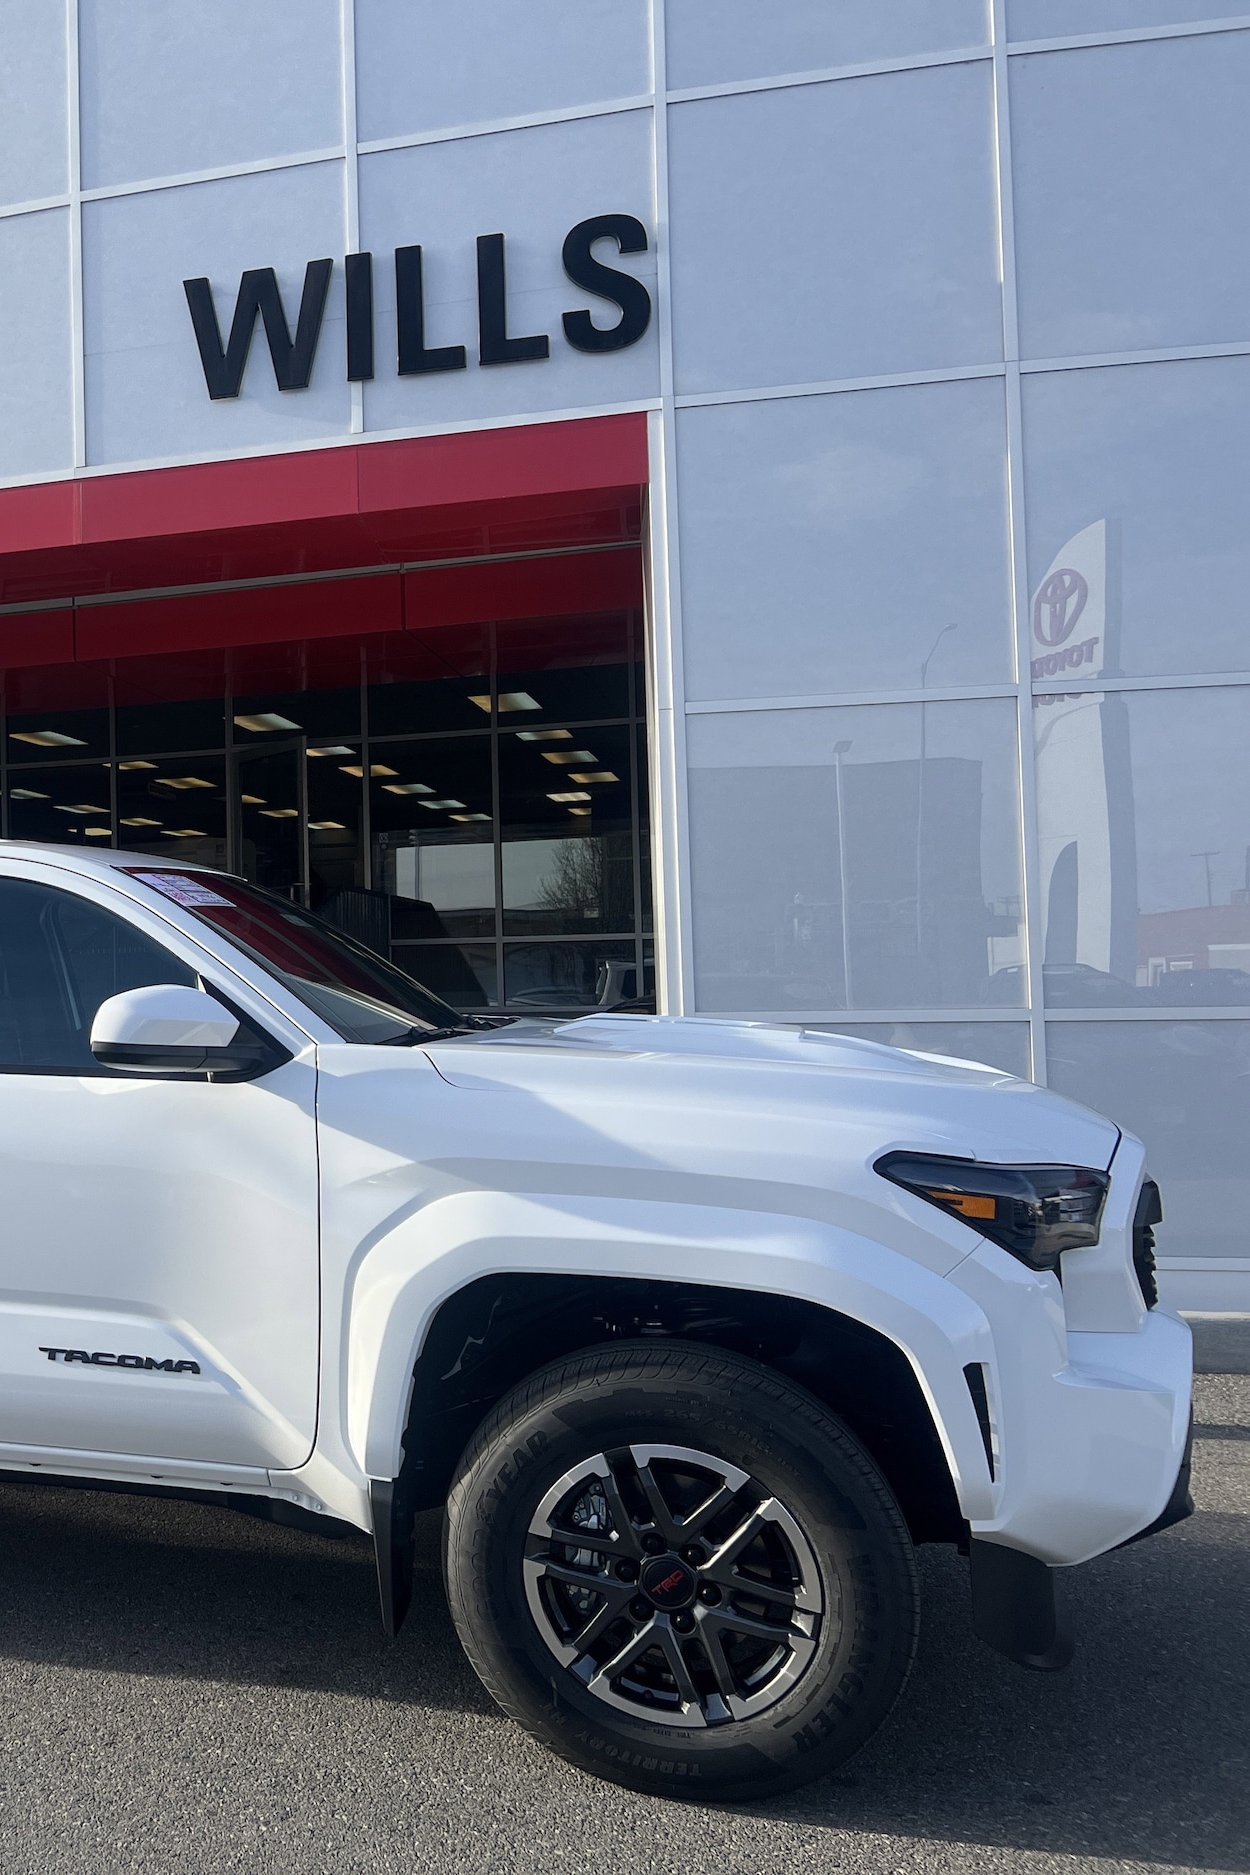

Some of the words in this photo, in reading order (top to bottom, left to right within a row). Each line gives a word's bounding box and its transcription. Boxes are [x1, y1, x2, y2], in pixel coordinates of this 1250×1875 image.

[183, 213, 651, 400] WILLS
[38, 1346, 201, 1374] TACOMA
[651, 1569, 684, 1595] TRD
[574, 1730, 703, 1778] TERRITORY
